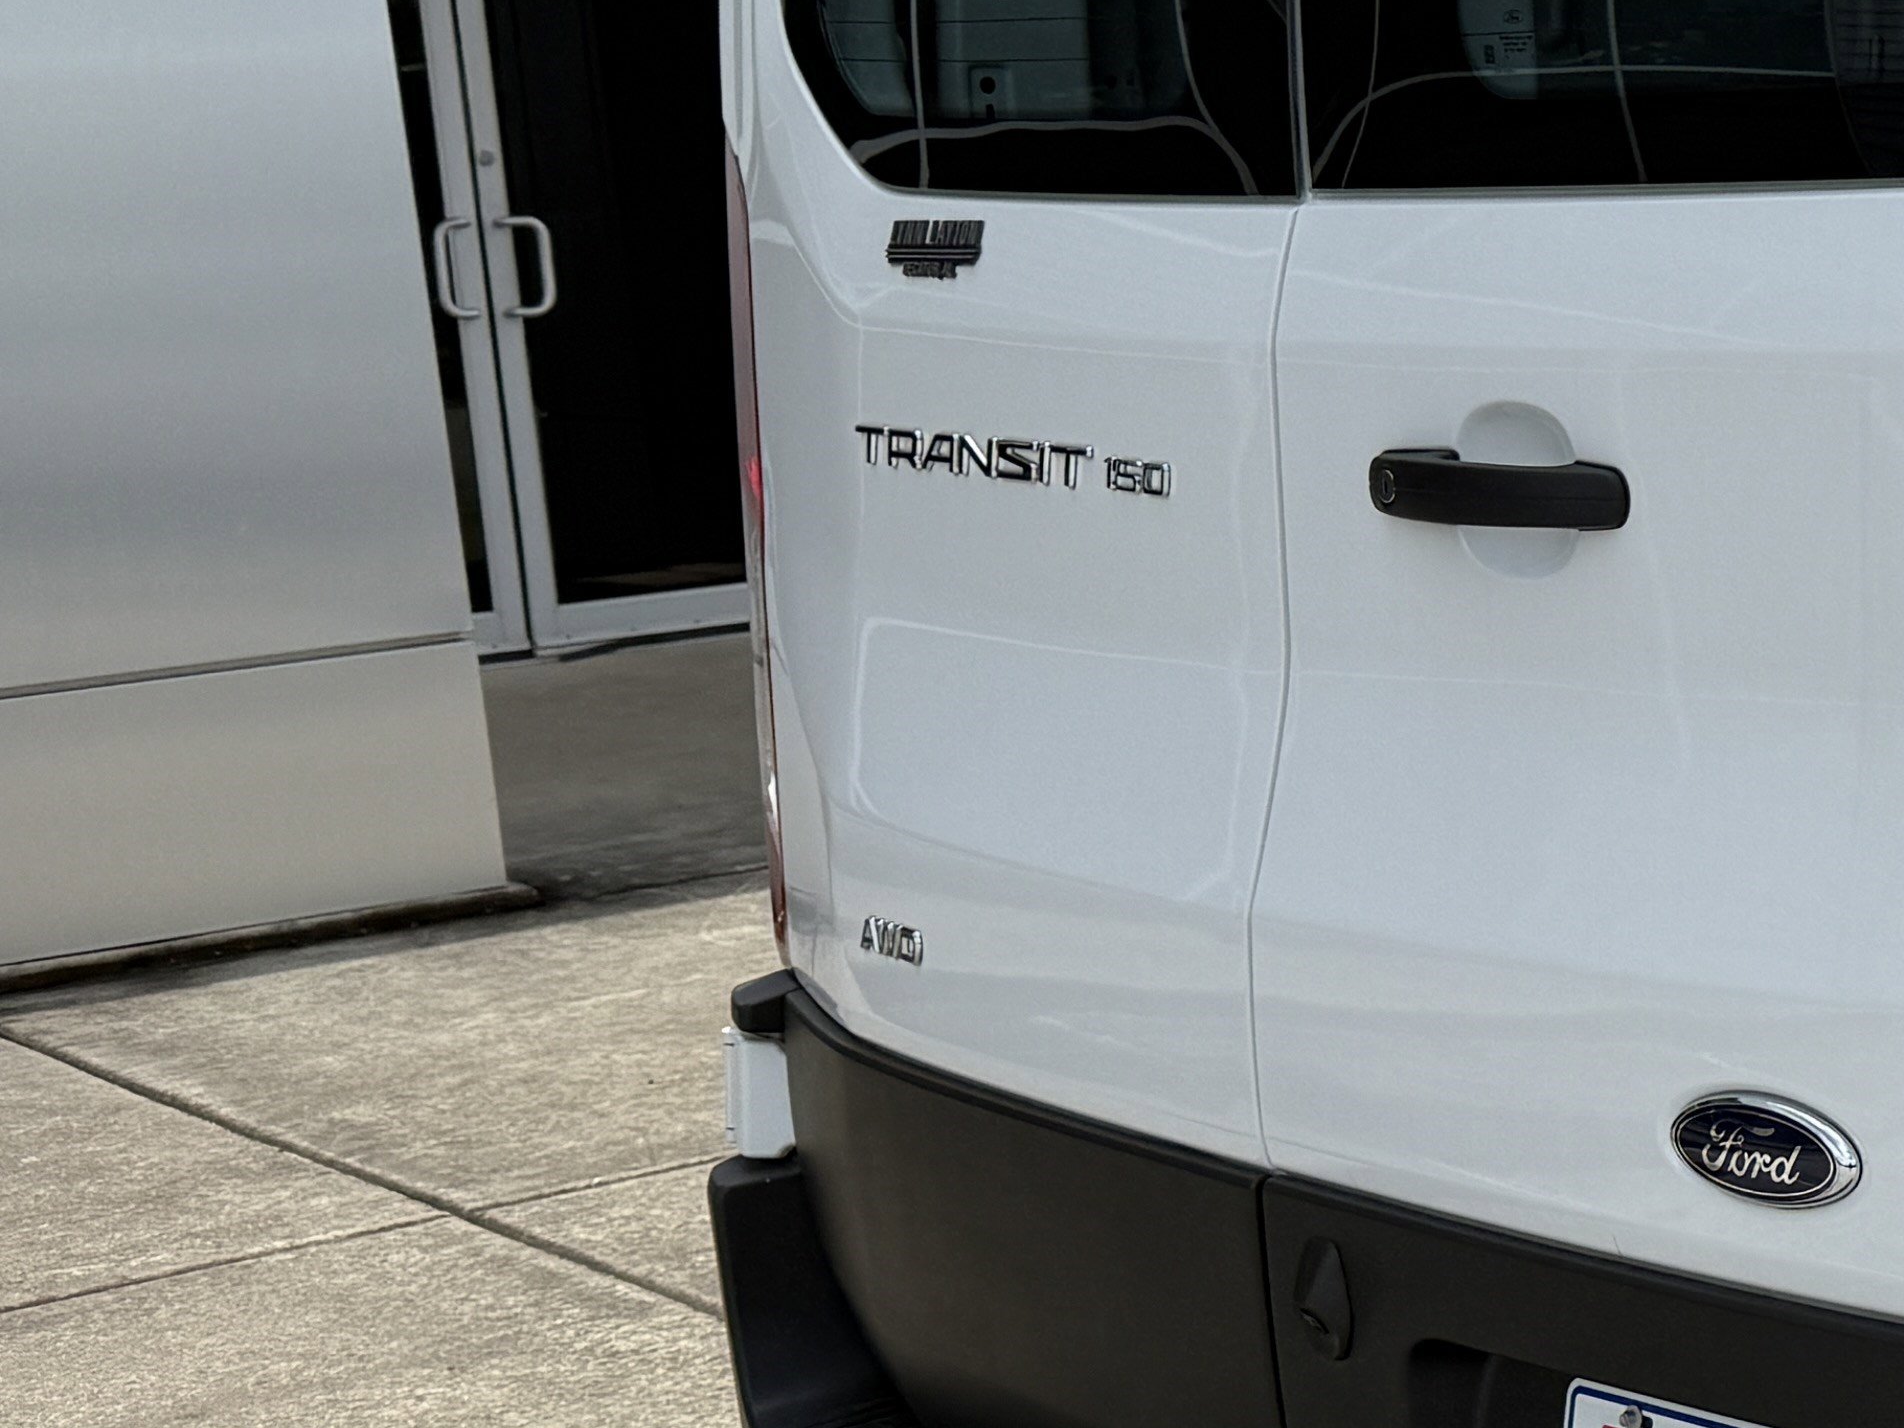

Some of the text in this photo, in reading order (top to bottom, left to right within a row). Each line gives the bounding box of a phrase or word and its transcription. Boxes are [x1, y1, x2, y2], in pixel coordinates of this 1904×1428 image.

[855, 424, 1171, 498] TRANSIT 150
[860, 915, 924, 967] AWD
[1701, 1117, 1803, 1186] Ford
